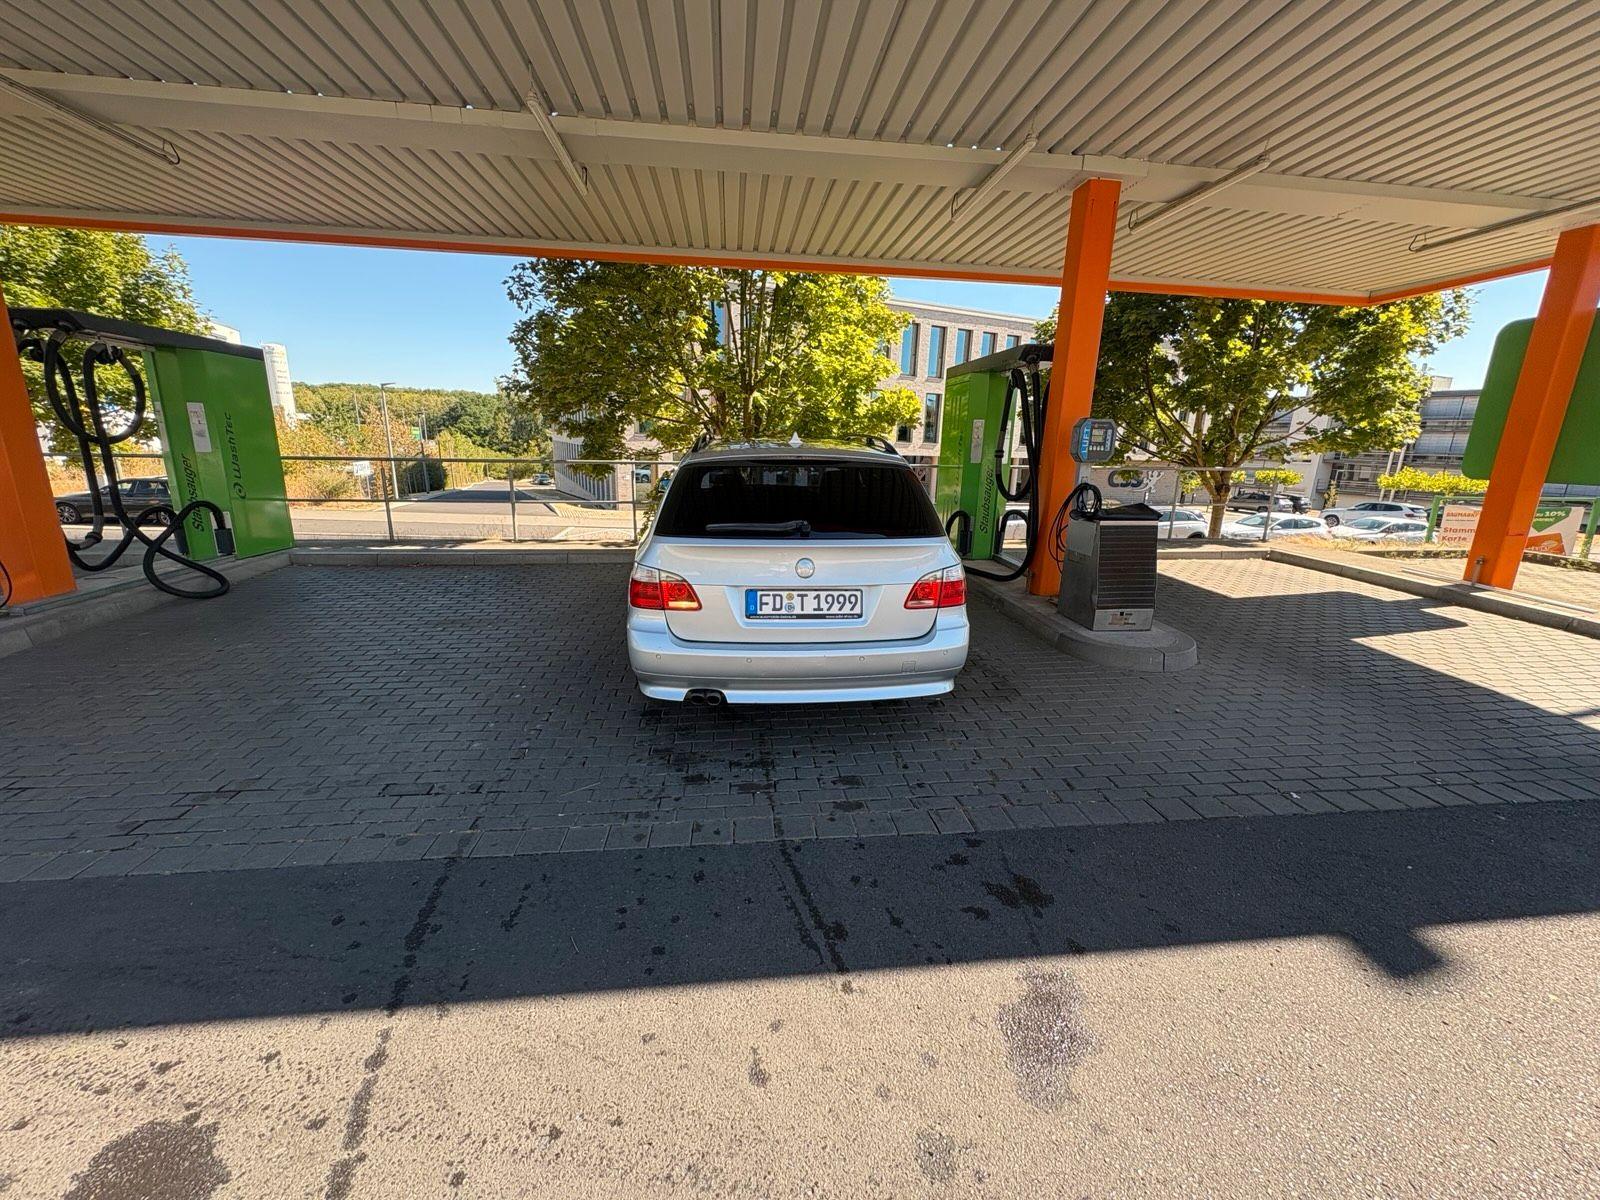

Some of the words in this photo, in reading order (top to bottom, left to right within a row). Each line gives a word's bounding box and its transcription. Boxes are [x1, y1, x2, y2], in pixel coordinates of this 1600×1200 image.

[980, 465, 996, 534] Staubsauger
[759, 593, 783, 612] FD
[797, 593, 808, 612] T
[813, 593, 859, 612] 1999
